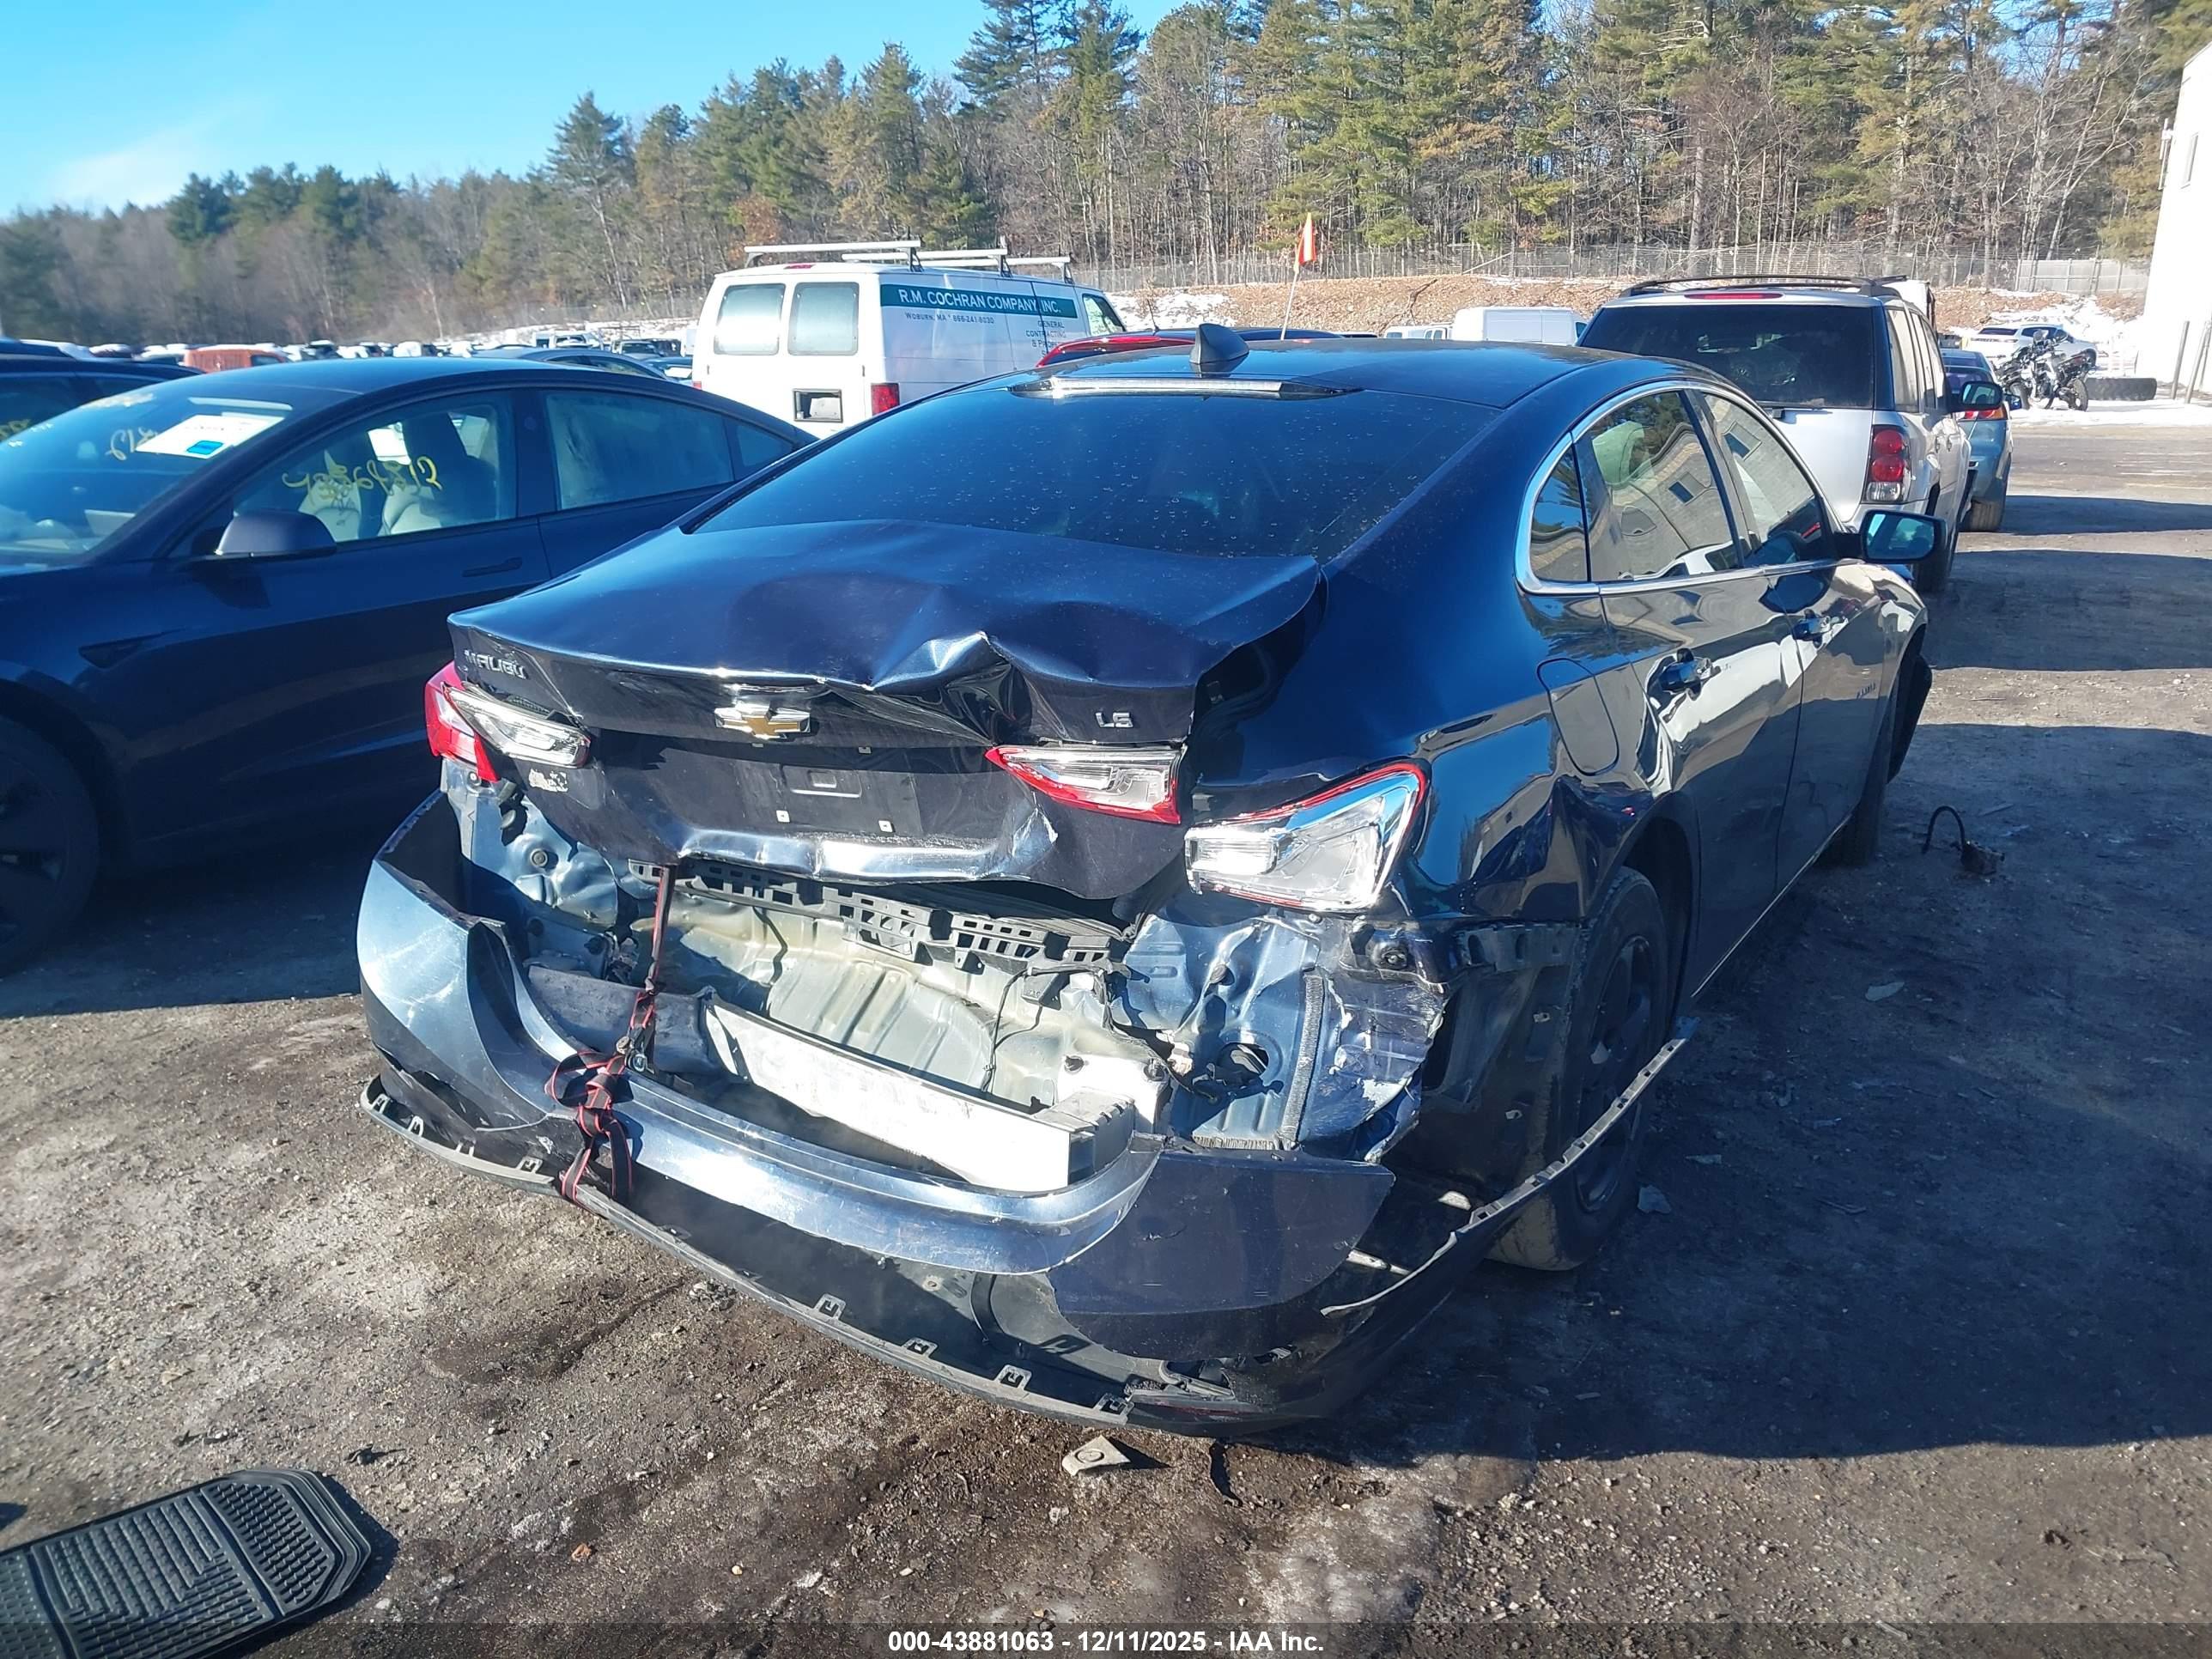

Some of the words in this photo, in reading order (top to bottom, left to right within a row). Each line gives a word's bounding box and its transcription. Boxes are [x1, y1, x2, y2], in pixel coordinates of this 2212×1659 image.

[898, 289, 927, 305] R.M.
[927, 291, 986, 308] COCHRAN
[1041, 300, 1062, 313] INC.
[1095, 711, 1133, 728] LS
